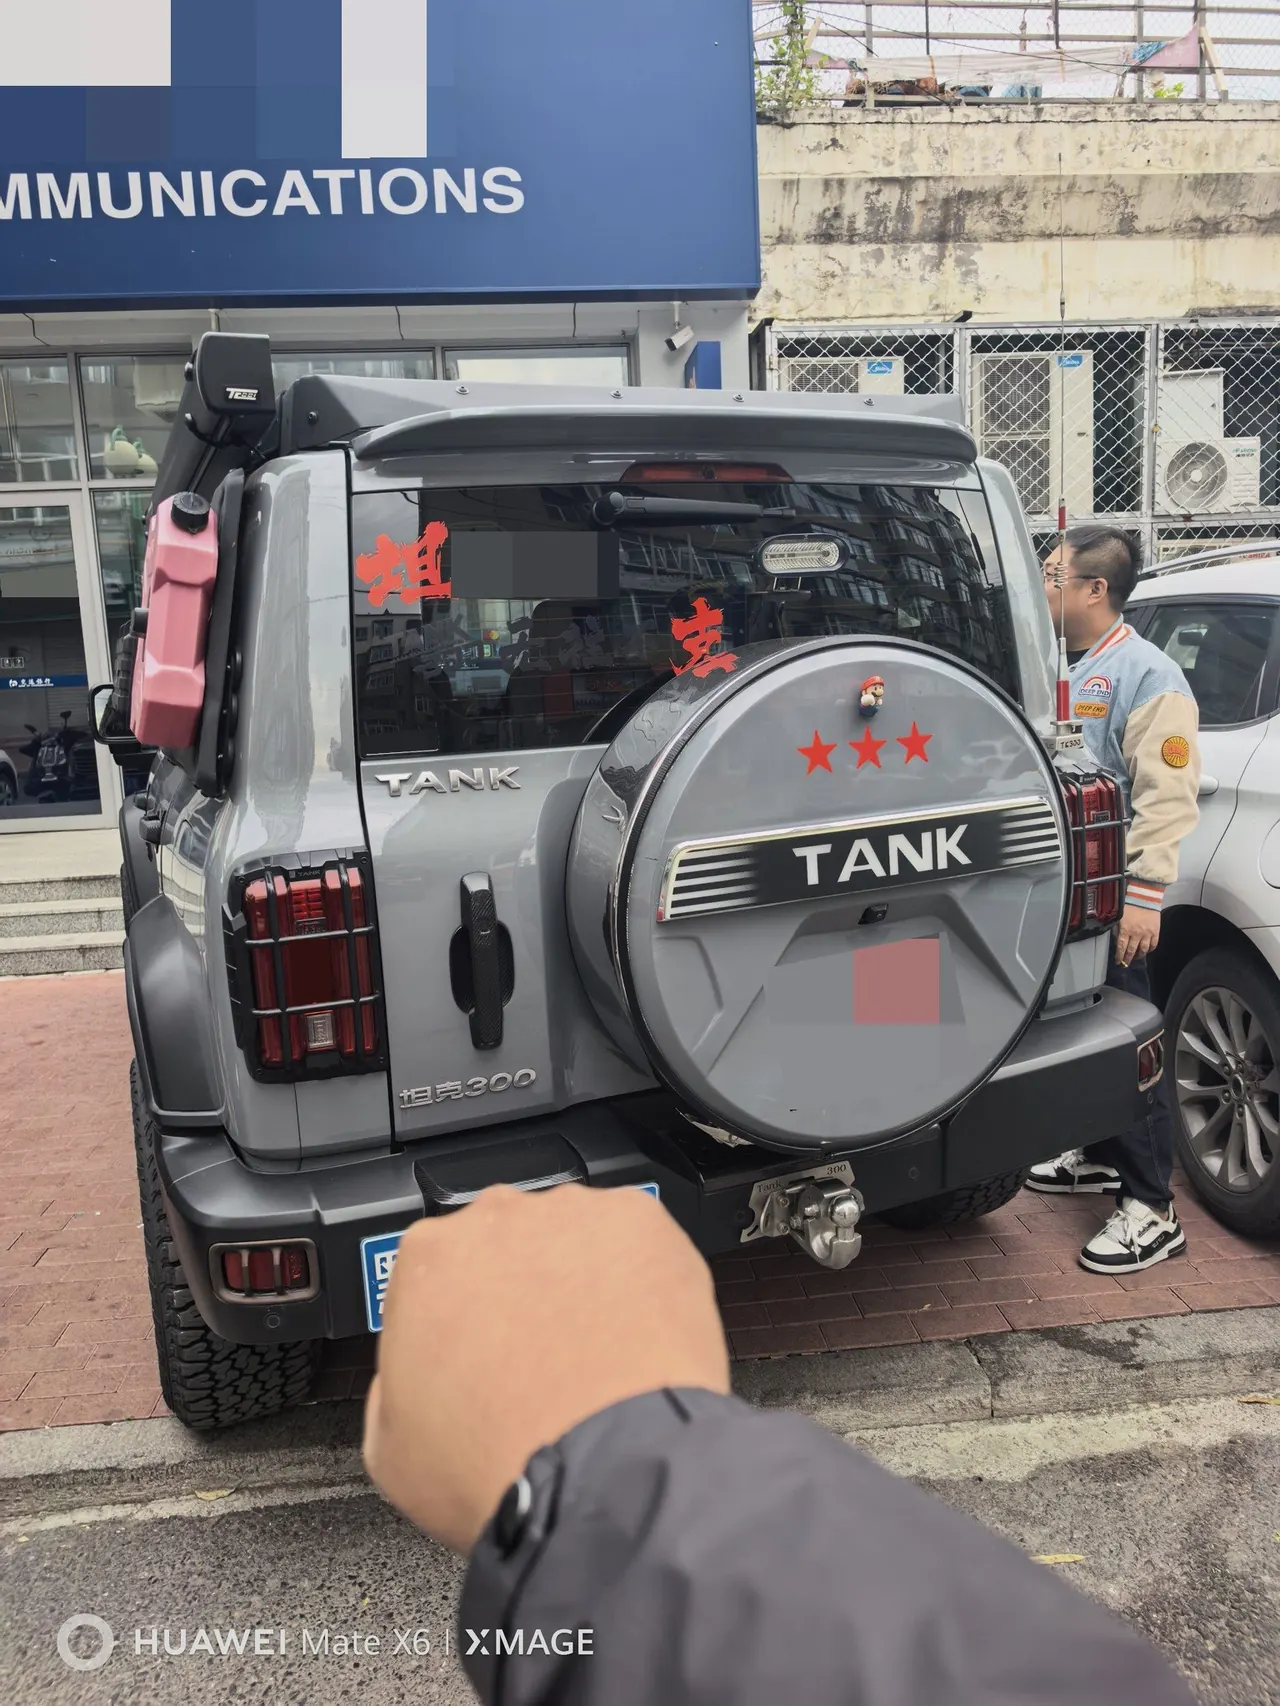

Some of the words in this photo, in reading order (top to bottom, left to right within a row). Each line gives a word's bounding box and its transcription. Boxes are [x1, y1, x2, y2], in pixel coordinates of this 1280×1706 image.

[0, 166, 525, 220] MMUNICATIONS
[374, 766, 522, 798] TANK
[792, 823, 973, 886] TANK
[399, 1067, 537, 1108] 坦克300
[756, 1181, 783, 1193] Tank
[826, 1163, 847, 1176] 300
